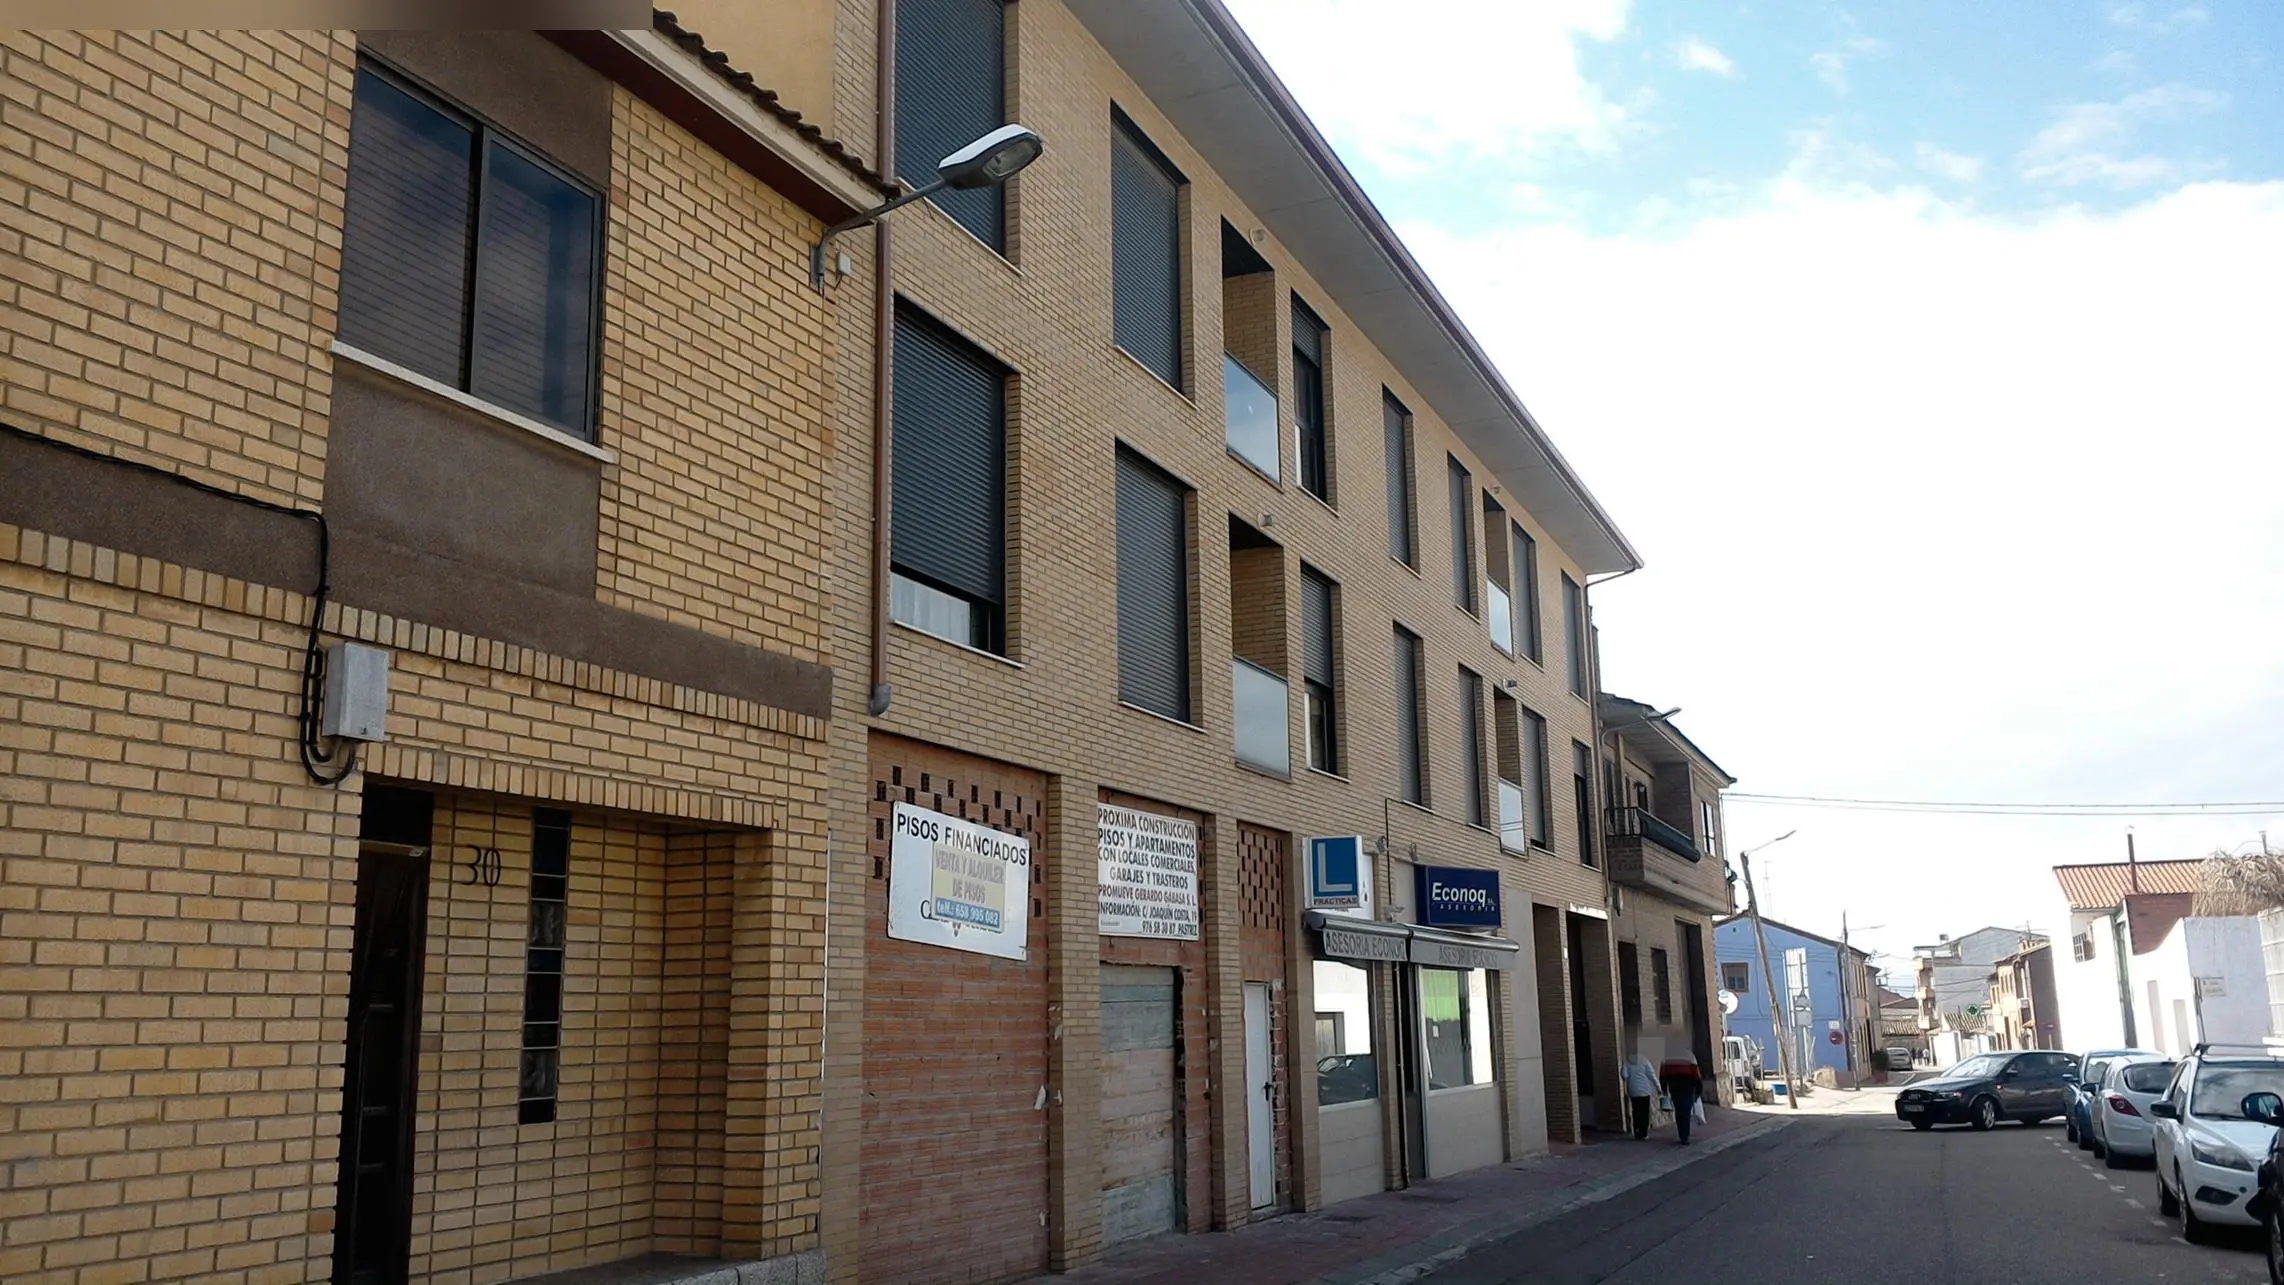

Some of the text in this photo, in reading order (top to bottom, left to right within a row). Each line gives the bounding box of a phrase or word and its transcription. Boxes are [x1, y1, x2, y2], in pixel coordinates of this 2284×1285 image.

[897, 813, 1027, 866] PISOS FINANCIADOS
[1097, 828, 1195, 859] PISOS Y APARTAMENTOS
[460, 844, 501, 887] 30
[935, 849, 1003, 884] VENTA Y ALQUILER
[1097, 846, 1117, 863] CON
[1118, 849, 1149, 867] LOCALES
[1317, 842, 1353, 892] L
[1109, 866, 1189, 890] GARAJES Y TRASTEROS
[952, 879, 986, 904] DE PISOS
[1098, 884, 1134, 900] PROMUEVE
[1135, 888, 1163, 903] GERARDO
[1432, 882, 1487, 908] Econoq
[1325, 931, 1370, 956] ASESORIA
